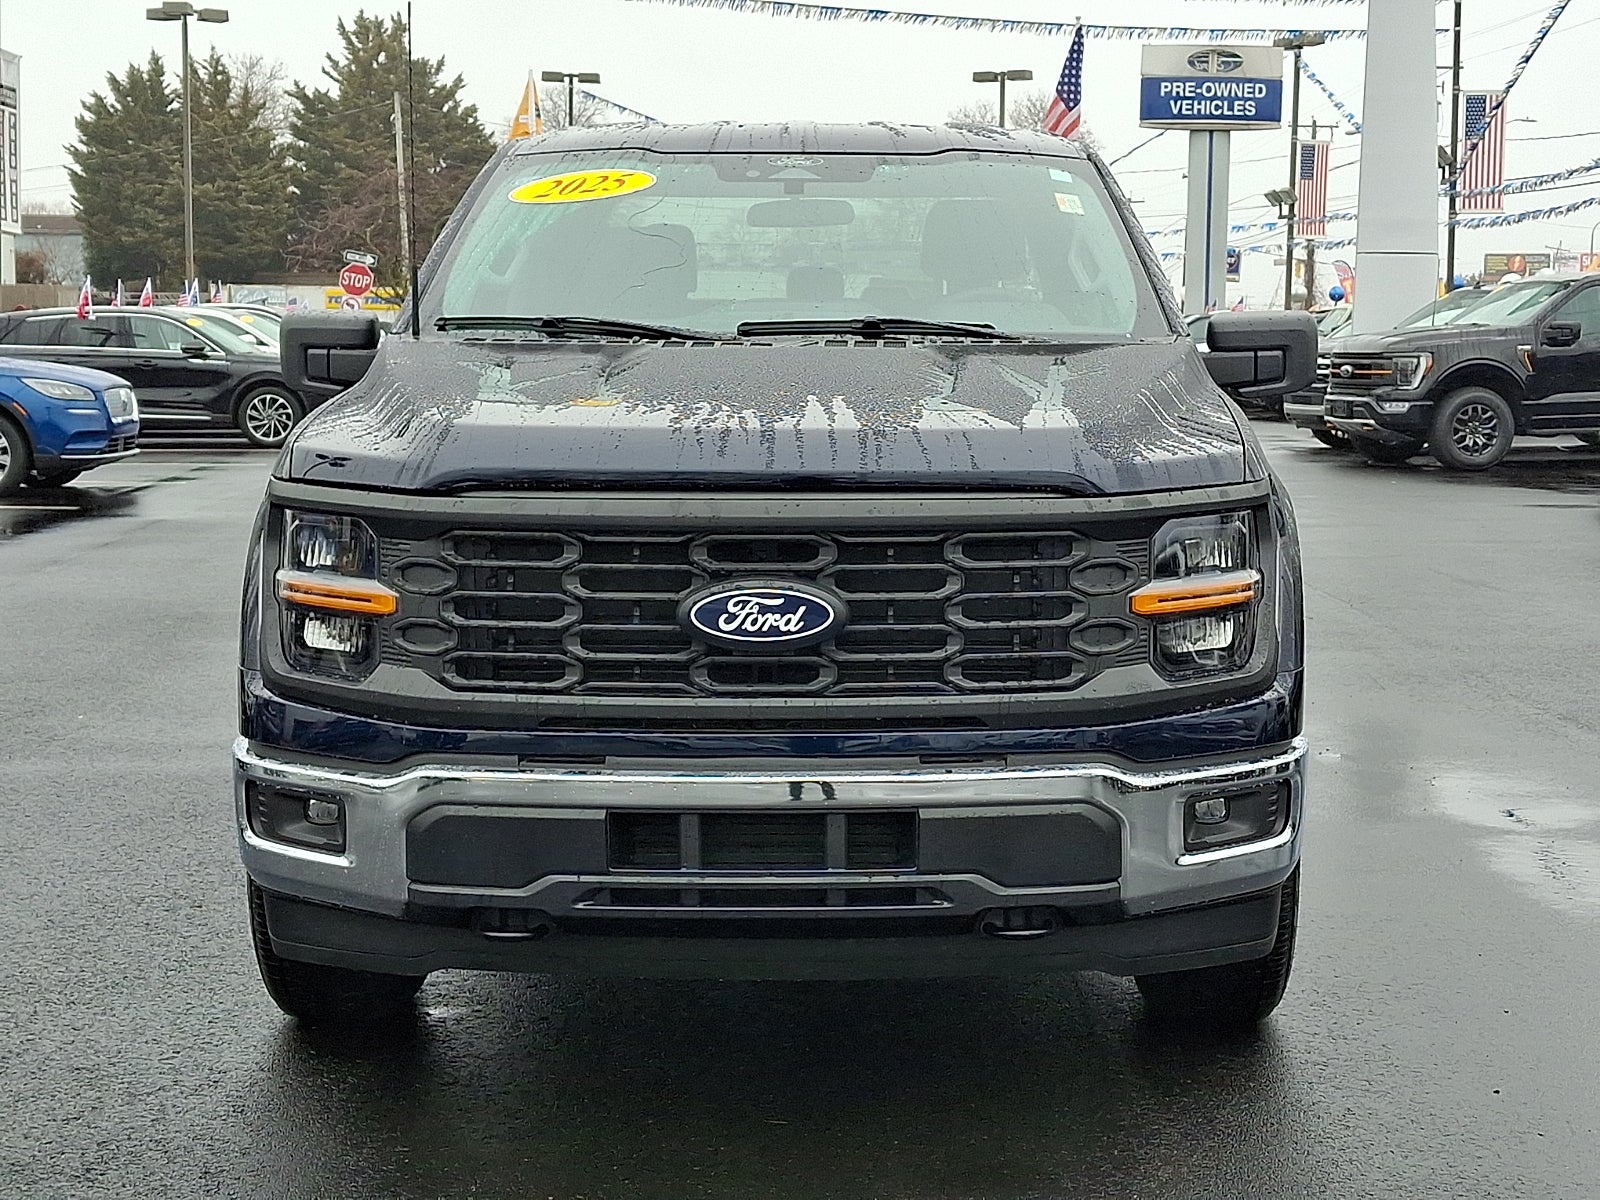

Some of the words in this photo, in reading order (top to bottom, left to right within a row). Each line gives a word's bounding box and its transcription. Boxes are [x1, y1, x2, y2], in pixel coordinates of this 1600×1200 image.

[1160, 82, 1267, 98] PRE-OWNED
[1169, 100, 1256, 115] VEHICLES
[533, 174, 635, 199] 2025
[342, 271, 371, 288] STOP
[718, 596, 807, 632] Ford
